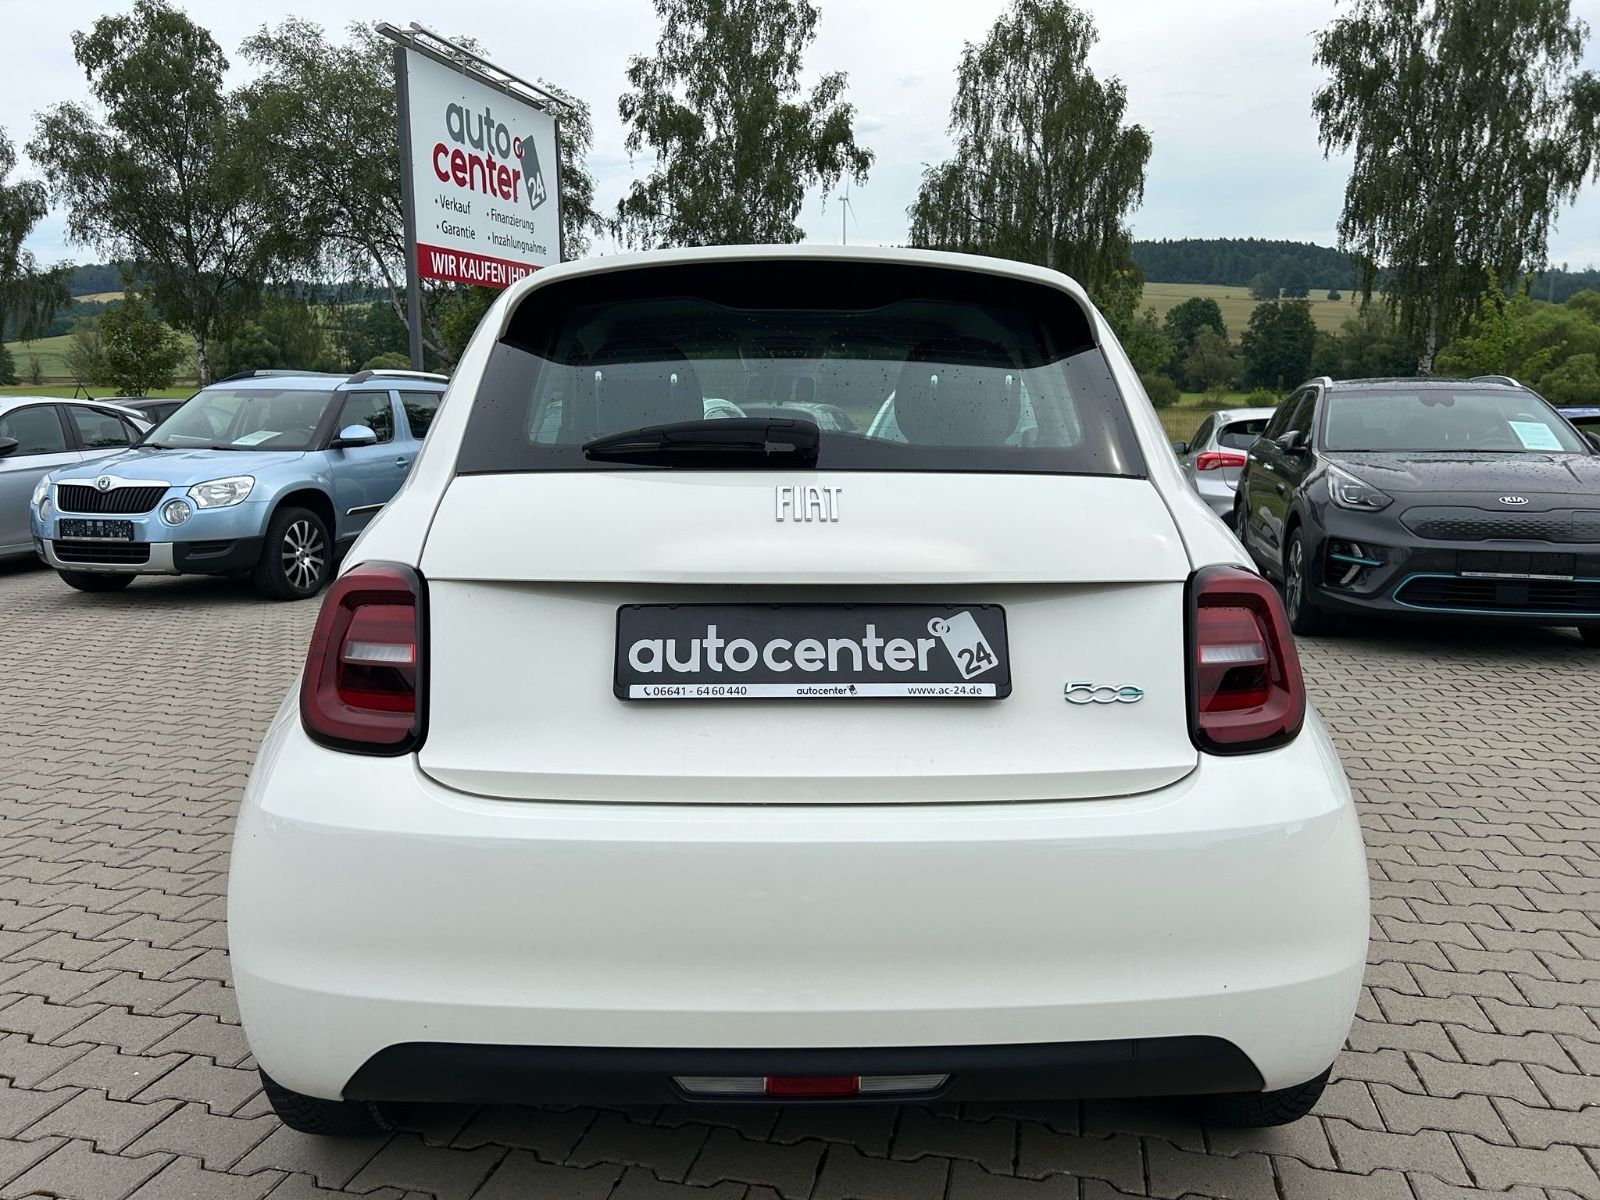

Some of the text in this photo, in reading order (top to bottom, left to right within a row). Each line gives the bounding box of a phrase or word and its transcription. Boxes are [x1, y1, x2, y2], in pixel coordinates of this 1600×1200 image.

[446, 102, 511, 159] auto
[433, 142, 521, 203] center
[528, 171, 545, 206] 24
[440, 194, 471, 214] Verkauf
[441, 220, 476, 240] Garantie
[490, 208, 534, 234] Finanzierung
[492, 232, 547, 255] Inzahlungnahme
[431, 251, 457, 276] WIR
[460, 257, 506, 284] KAUFEN
[776, 485, 842, 522] FIAT
[628, 624, 936, 672] autocenter
[957, 641, 993, 675] 24
[653, 686, 686, 696] 06641
[796, 685, 847, 695] autocenter
[907, 685, 983, 695] www.ac-24.de
